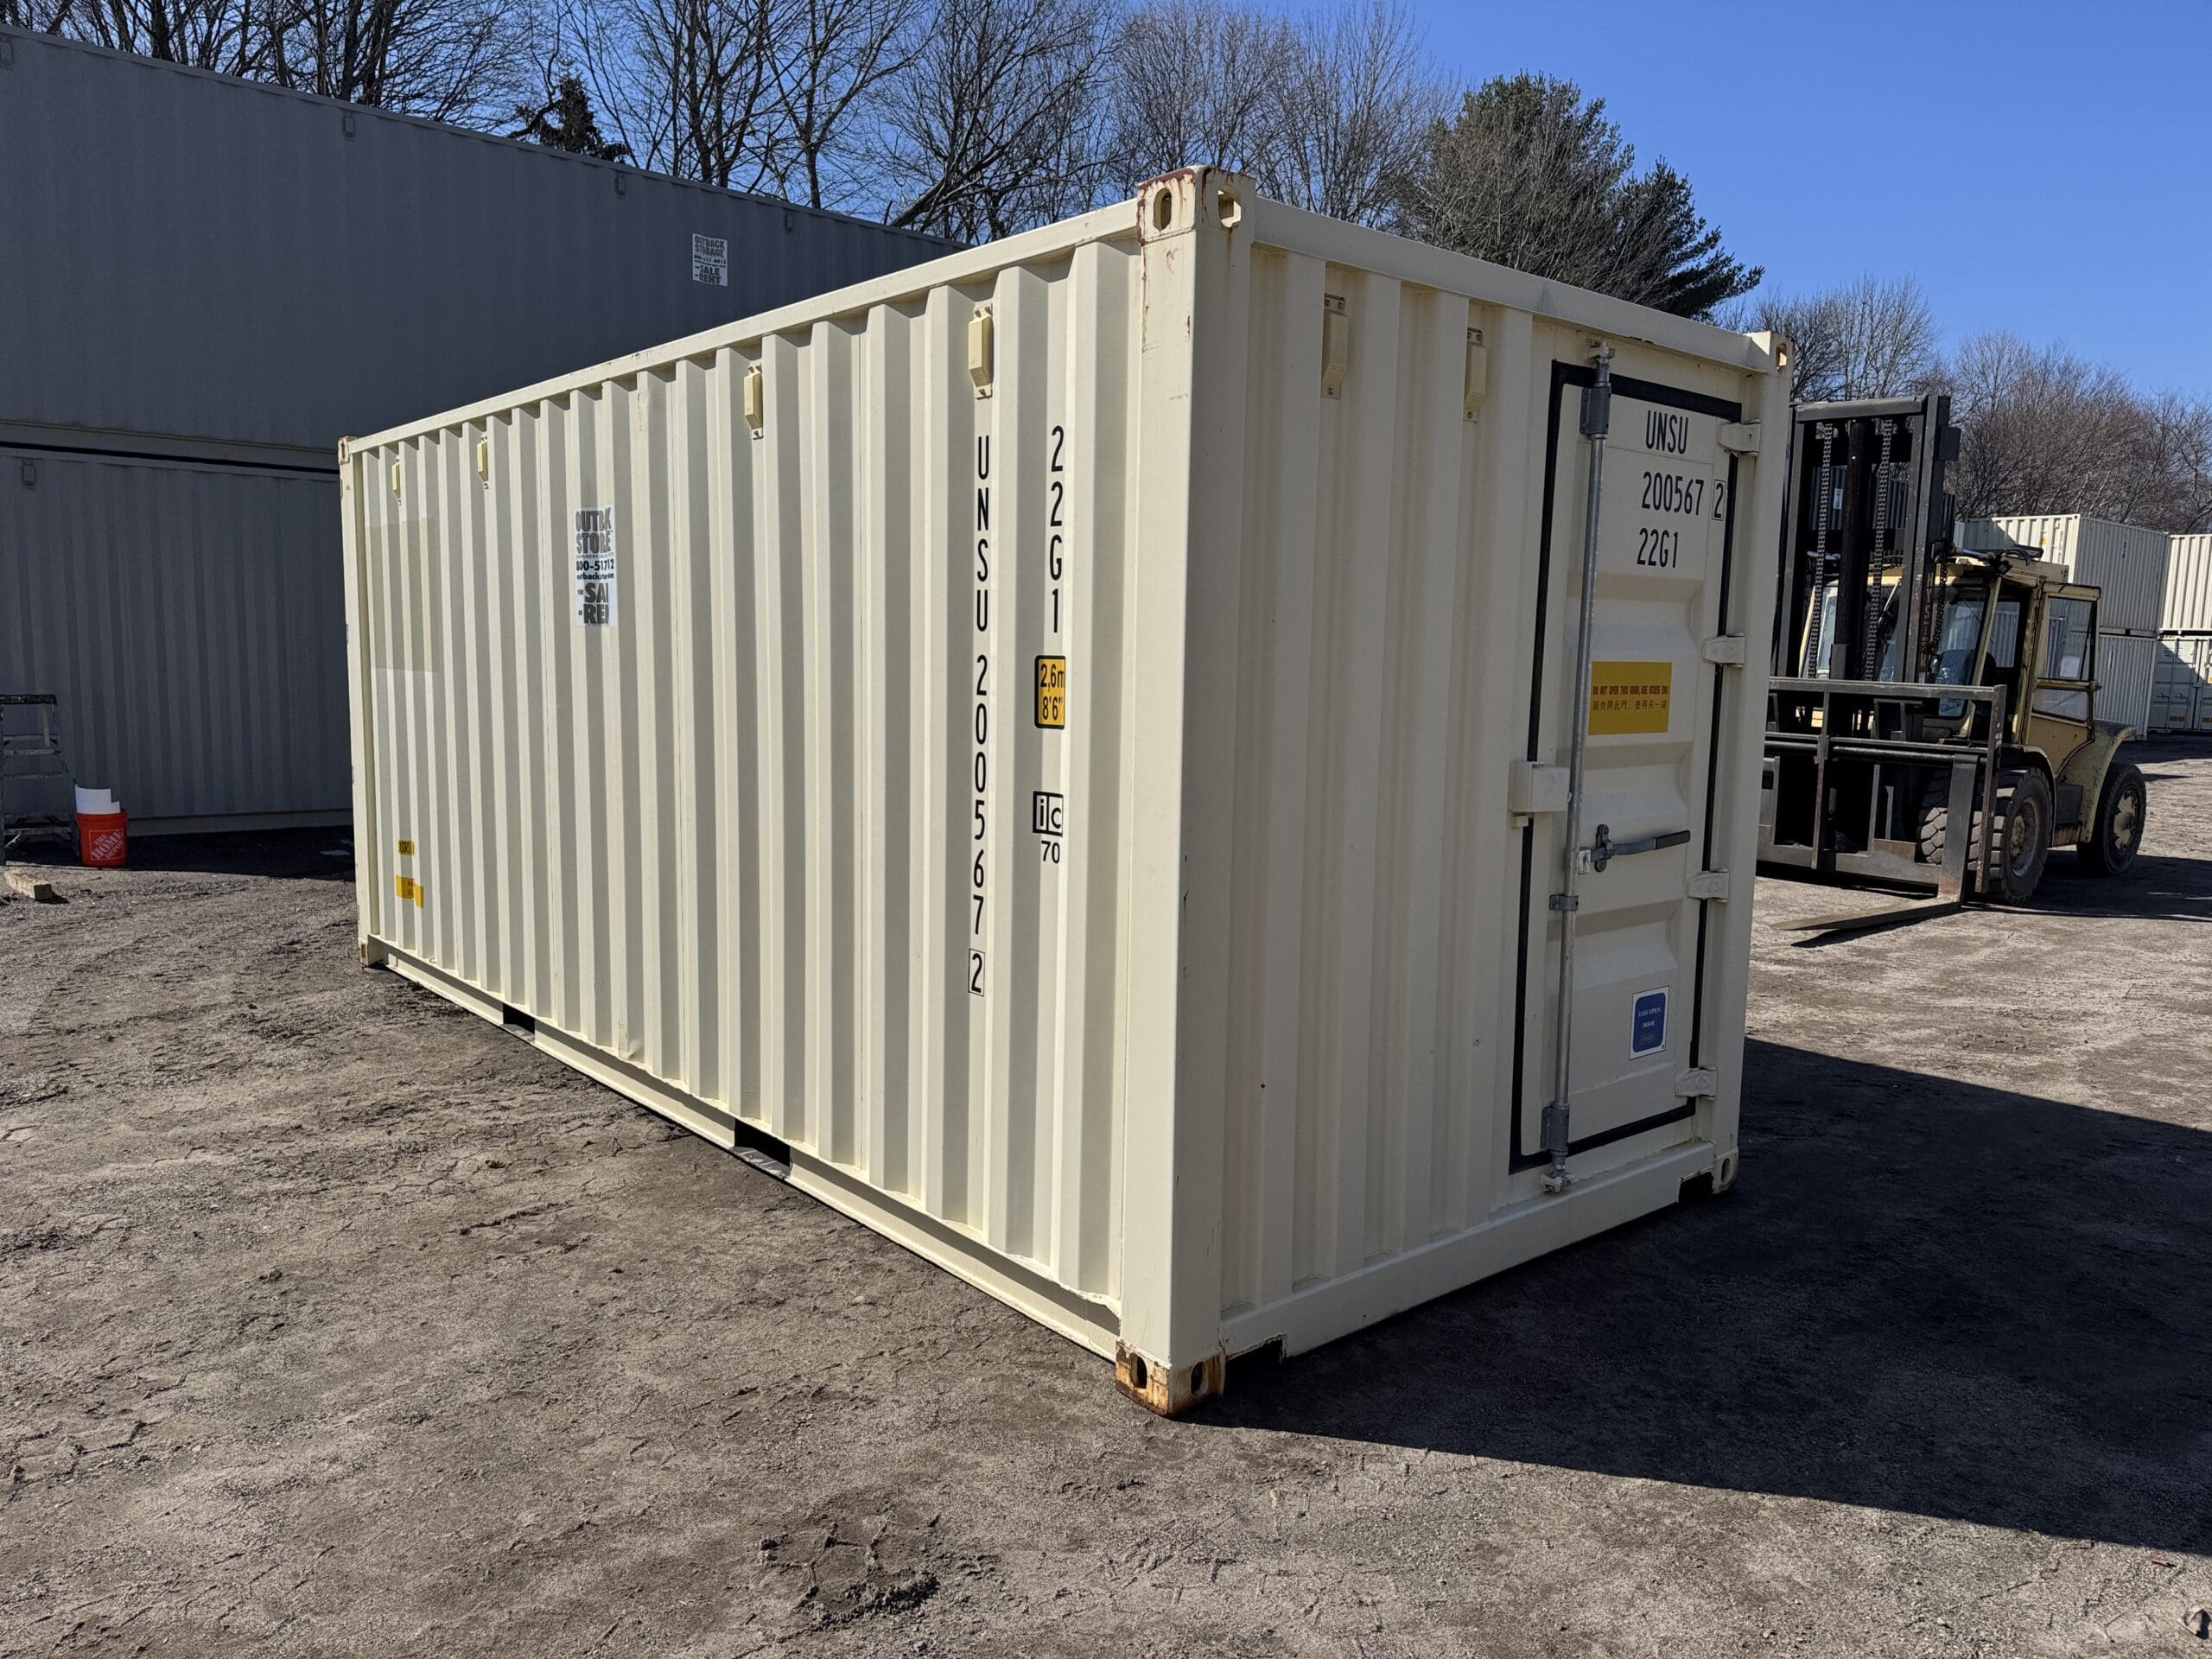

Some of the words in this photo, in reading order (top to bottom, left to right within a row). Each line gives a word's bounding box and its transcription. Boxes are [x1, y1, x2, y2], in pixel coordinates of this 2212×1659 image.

[695, 235, 725, 249] OUTBACK
[695, 245, 724, 257] STORAGE
[699, 273, 721, 284] RENT
[700, 264, 721, 276] SALE
[1645, 410, 1688, 454] UNSU
[1642, 471, 1705, 516] 200567
[1713, 482, 1725, 518] 2
[976, 435, 989, 632] UNSU
[1049, 425, 1065, 633] 22G1
[1637, 527, 1679, 569] 22G1
[584, 582, 609, 603] SA
[583, 603, 610, 625] RE
[973, 654, 988, 935] 200567
[92, 830, 124, 859] HOME
[105, 839, 124, 860] DEPOT
[1040, 840, 1061, 864] 70
[971, 952, 983, 994] 2
